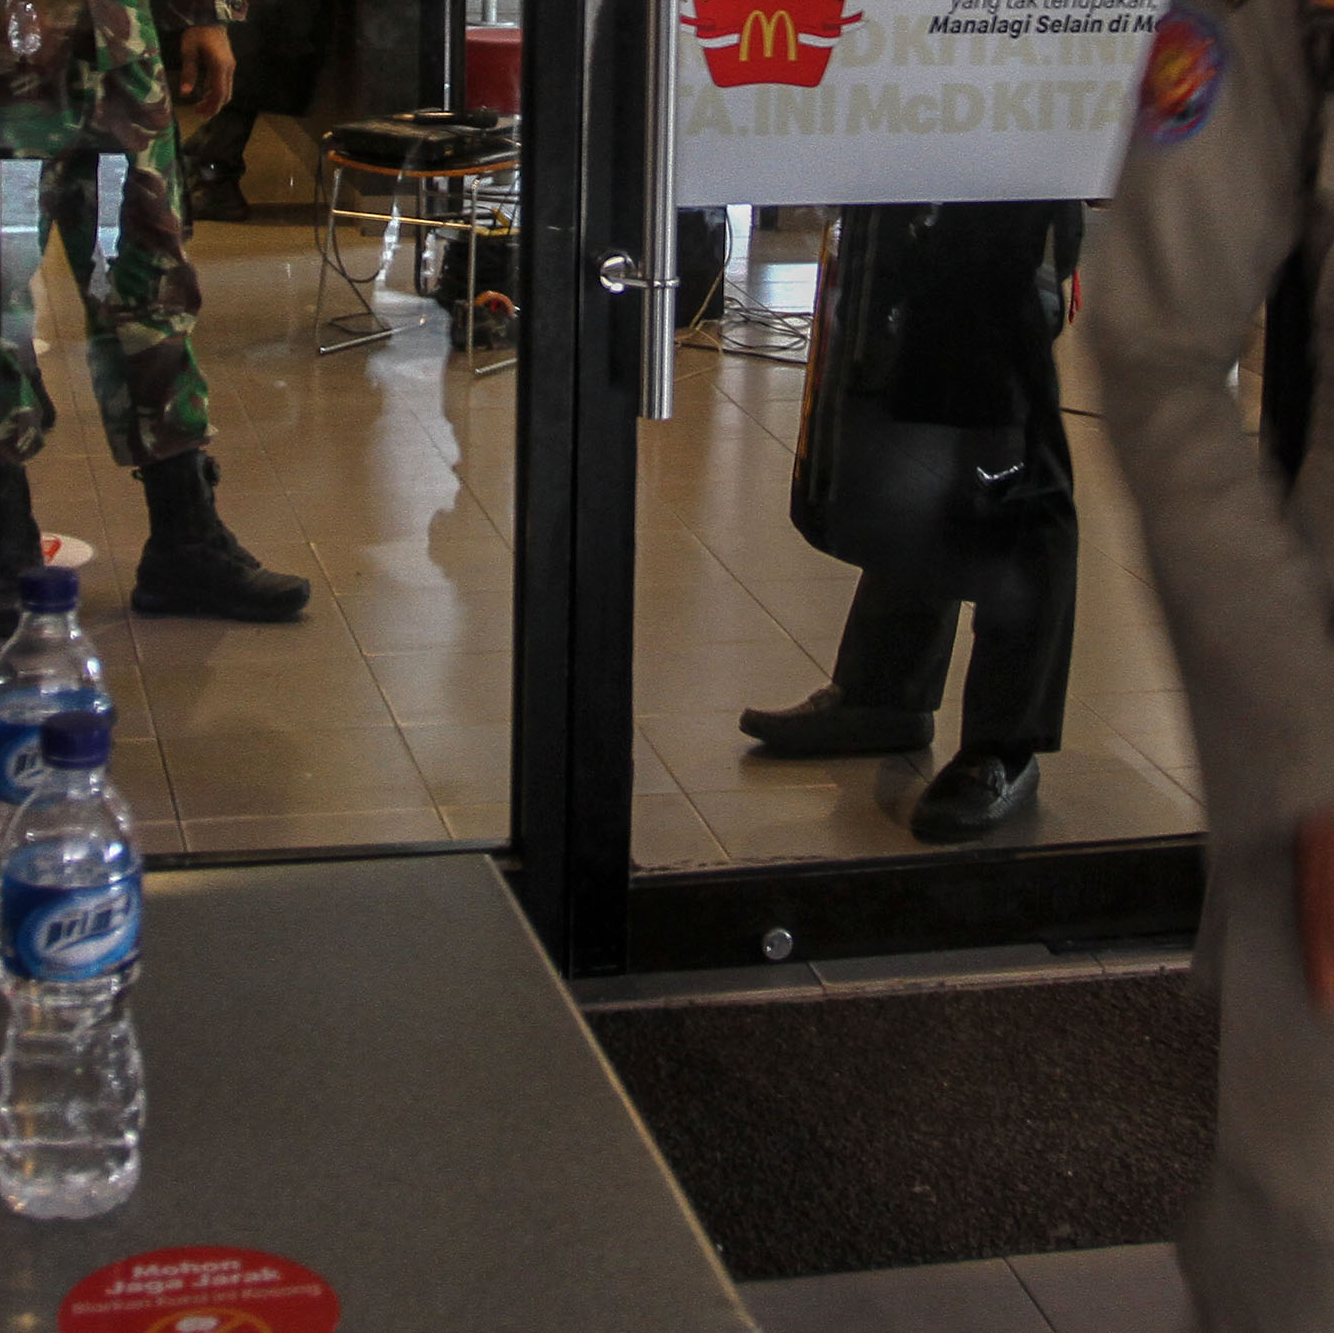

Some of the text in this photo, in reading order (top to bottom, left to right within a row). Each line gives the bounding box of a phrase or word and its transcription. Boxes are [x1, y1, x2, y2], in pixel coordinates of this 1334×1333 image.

[928, 16, 1033, 38] Manalagi
[1036, 16, 1103, 35] Selain
[1108, 16, 1130, 34] di
[132, 1259, 242, 1279] Mohon
[105, 1267, 282, 1296] Jaga Jarak
